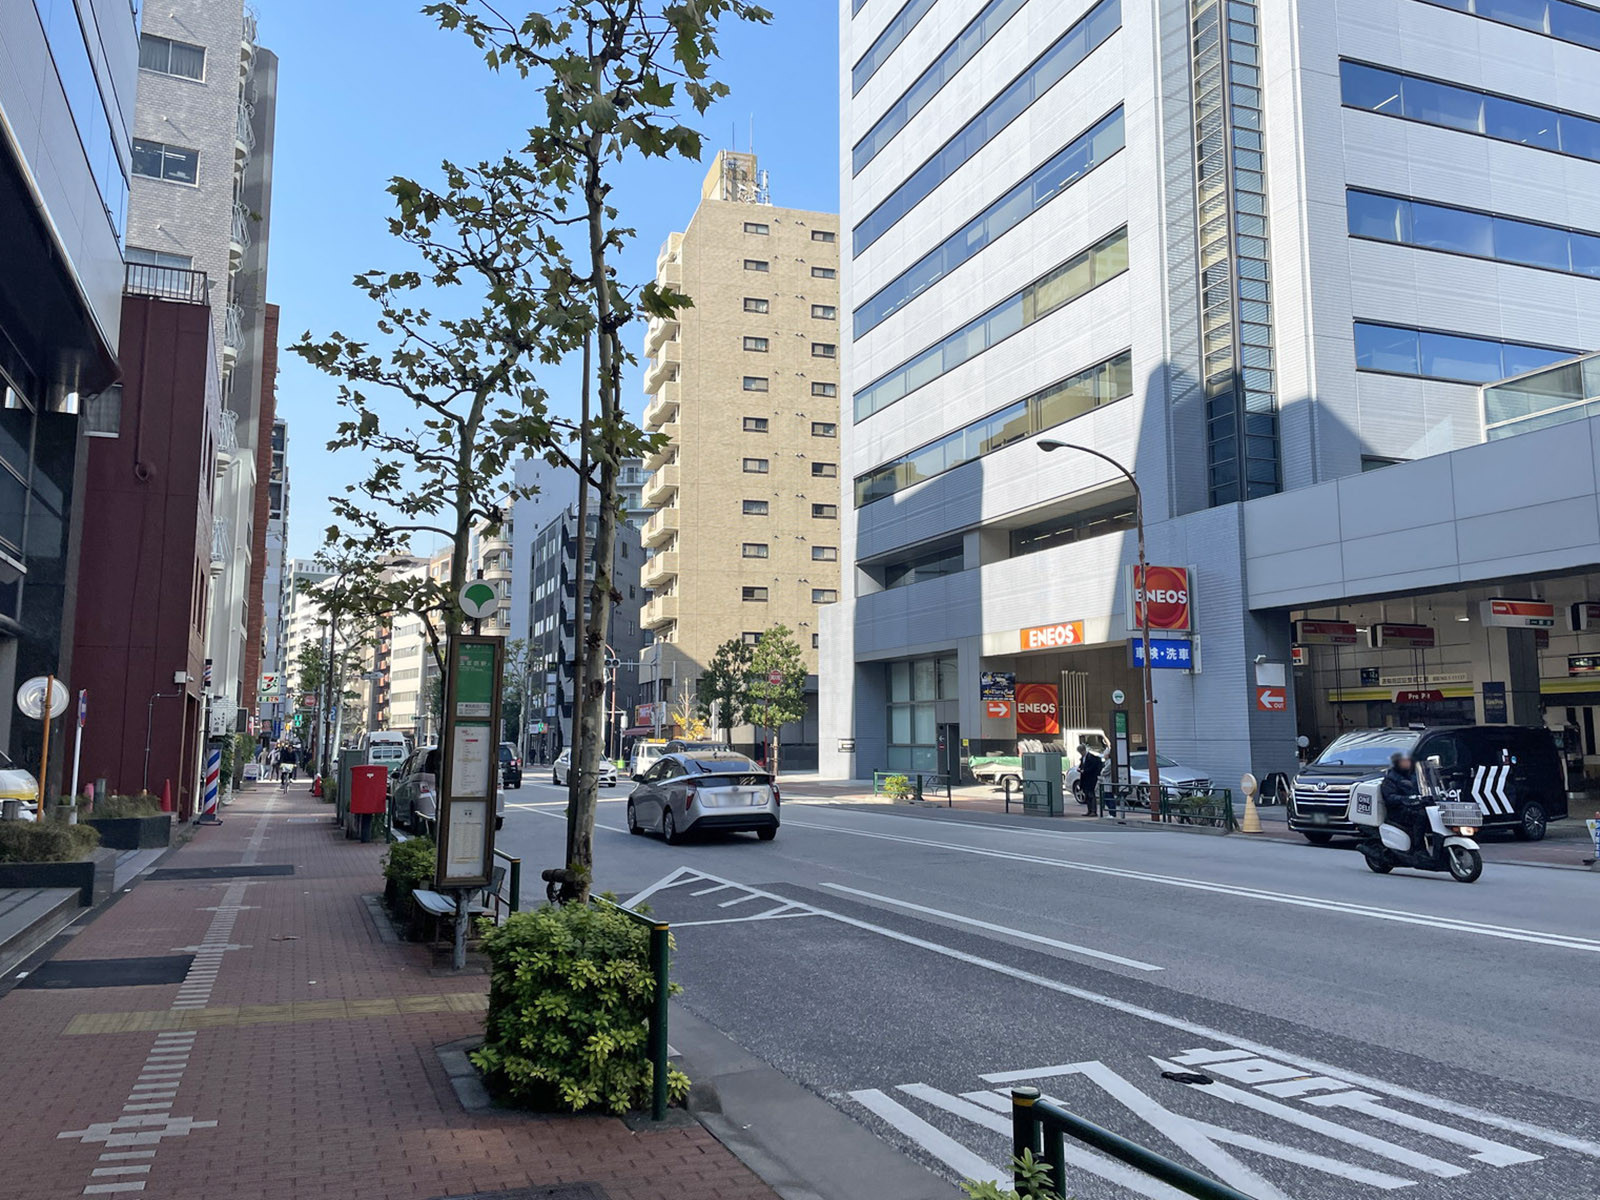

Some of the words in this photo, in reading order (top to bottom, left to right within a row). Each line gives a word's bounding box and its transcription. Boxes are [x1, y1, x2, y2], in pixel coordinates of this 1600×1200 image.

[1135, 589, 1188, 604] ENEOS
[1029, 624, 1074, 647] ENEOS
[1135, 646, 1190, 661] 車検・洗車
[1018, 702, 1056, 714] ENEOS
[1358, 795, 1370, 804] ONE
[1358, 803, 1370, 812] DELI
